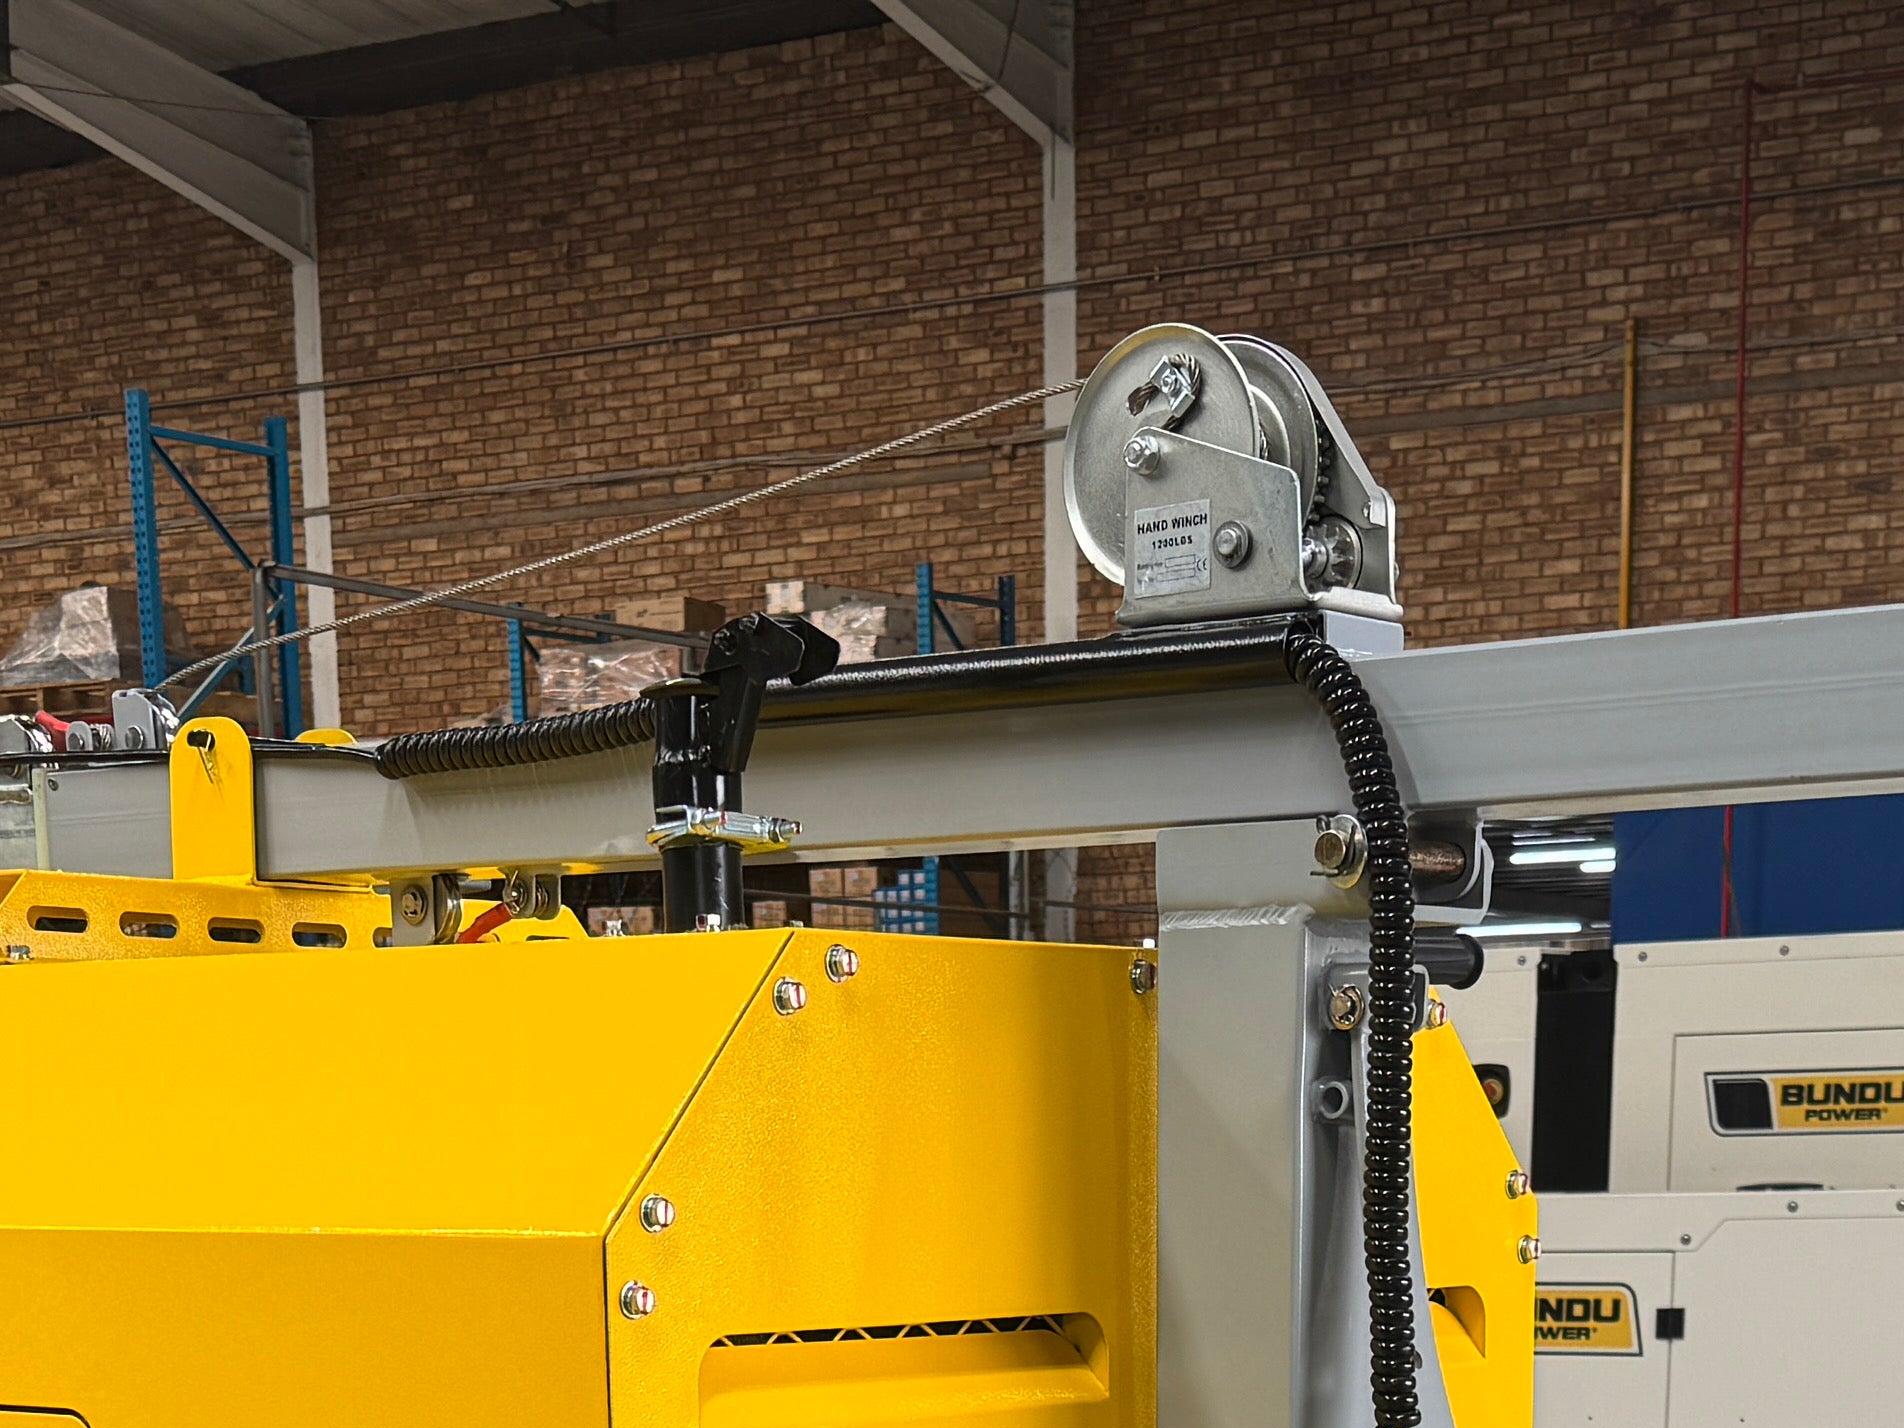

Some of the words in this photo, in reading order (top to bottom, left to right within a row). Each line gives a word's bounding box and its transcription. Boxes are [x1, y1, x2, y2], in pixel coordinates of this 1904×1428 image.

[1137, 520, 1168, 535] HAND
[1171, 513, 1207, 529] WINCH
[1805, 1107, 1881, 1122] POWER
[1534, 1298, 1621, 1323] NDU
[1534, 1326, 1590, 1341] WER
